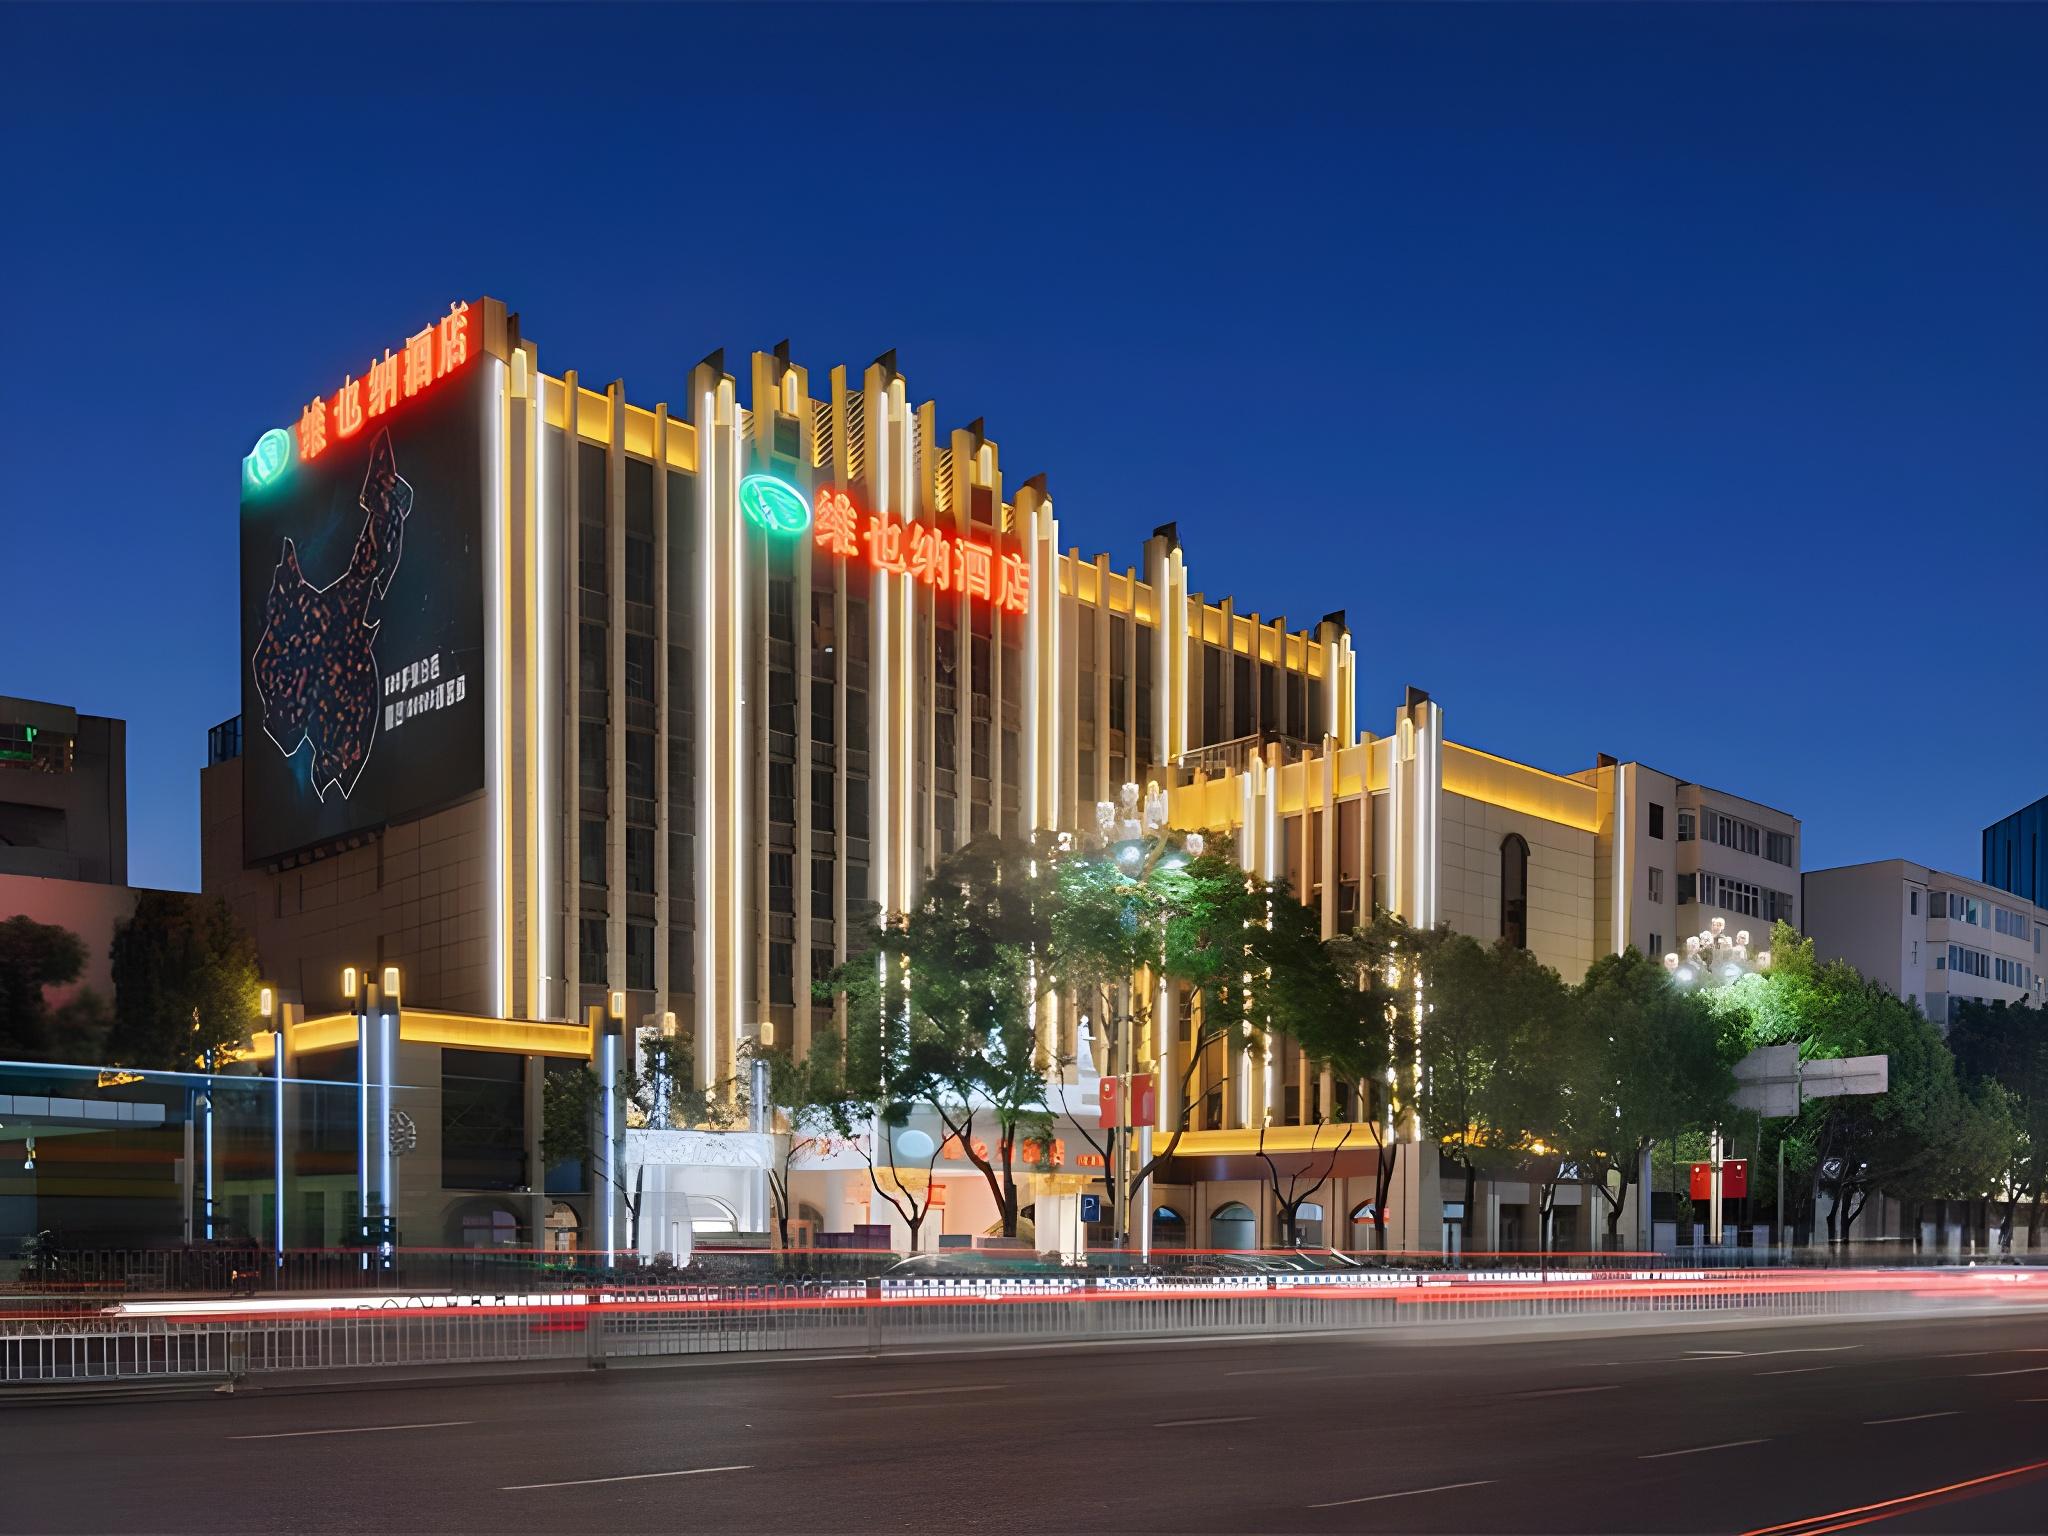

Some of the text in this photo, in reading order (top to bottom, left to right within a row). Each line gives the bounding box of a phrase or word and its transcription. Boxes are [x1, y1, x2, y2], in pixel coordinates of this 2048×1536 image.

[300, 300, 469, 460] 维也纳酒店
[814, 490, 1031, 614] 维也纳酒店
[1083, 1197, 1095, 1218] P
